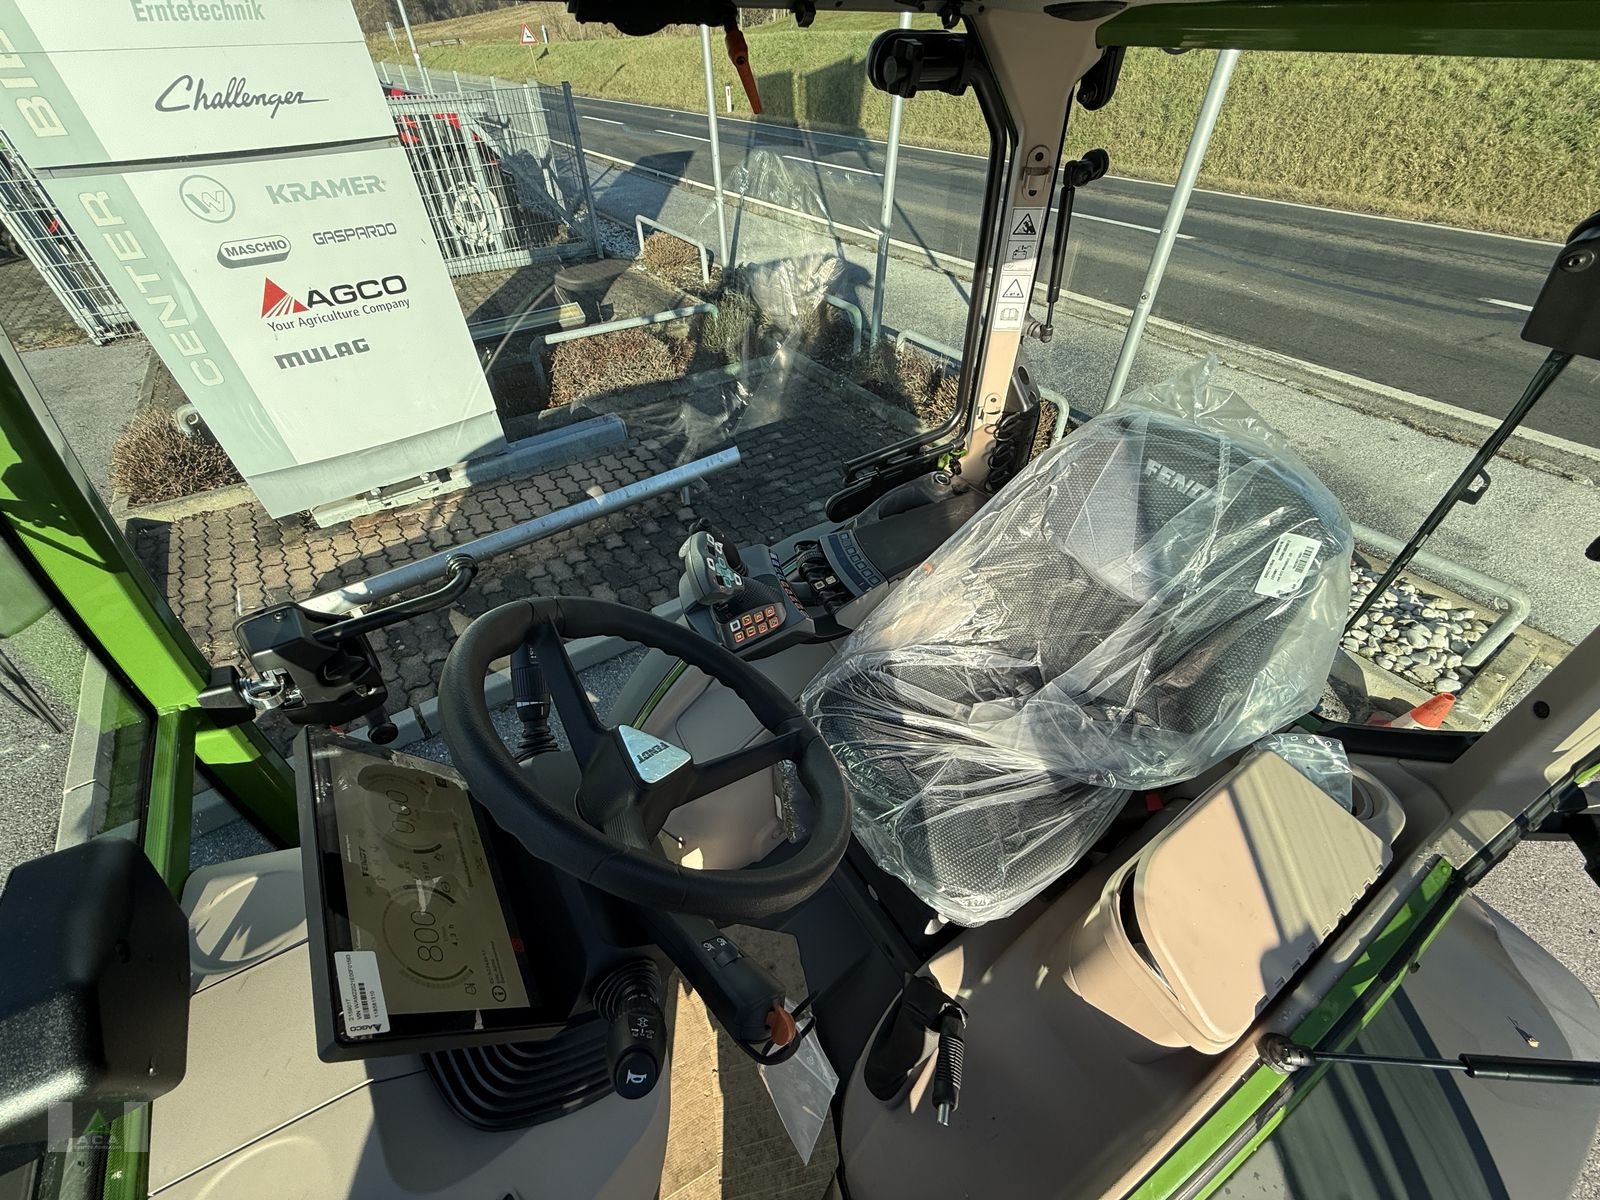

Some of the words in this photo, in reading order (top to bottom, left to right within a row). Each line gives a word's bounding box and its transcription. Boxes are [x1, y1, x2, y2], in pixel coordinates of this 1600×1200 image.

[130, 0, 265, 22] Erntetechnik
[155, 75, 329, 119] Challenger
[265, 175, 386, 204] KRAMER
[224, 239, 288, 258] MASCHIO
[312, 222, 398, 246] GASPARDO
[79, 191, 226, 387] CENTER
[307, 275, 408, 308] AGCO
[267, 317, 295, 332] Your
[298, 307, 361, 329] Agriculture
[362, 298, 411, 315] Company
[274, 338, 370, 369] MULAG
[637, 742, 669, 764] FENDT
[410, 910, 444, 963] 800
